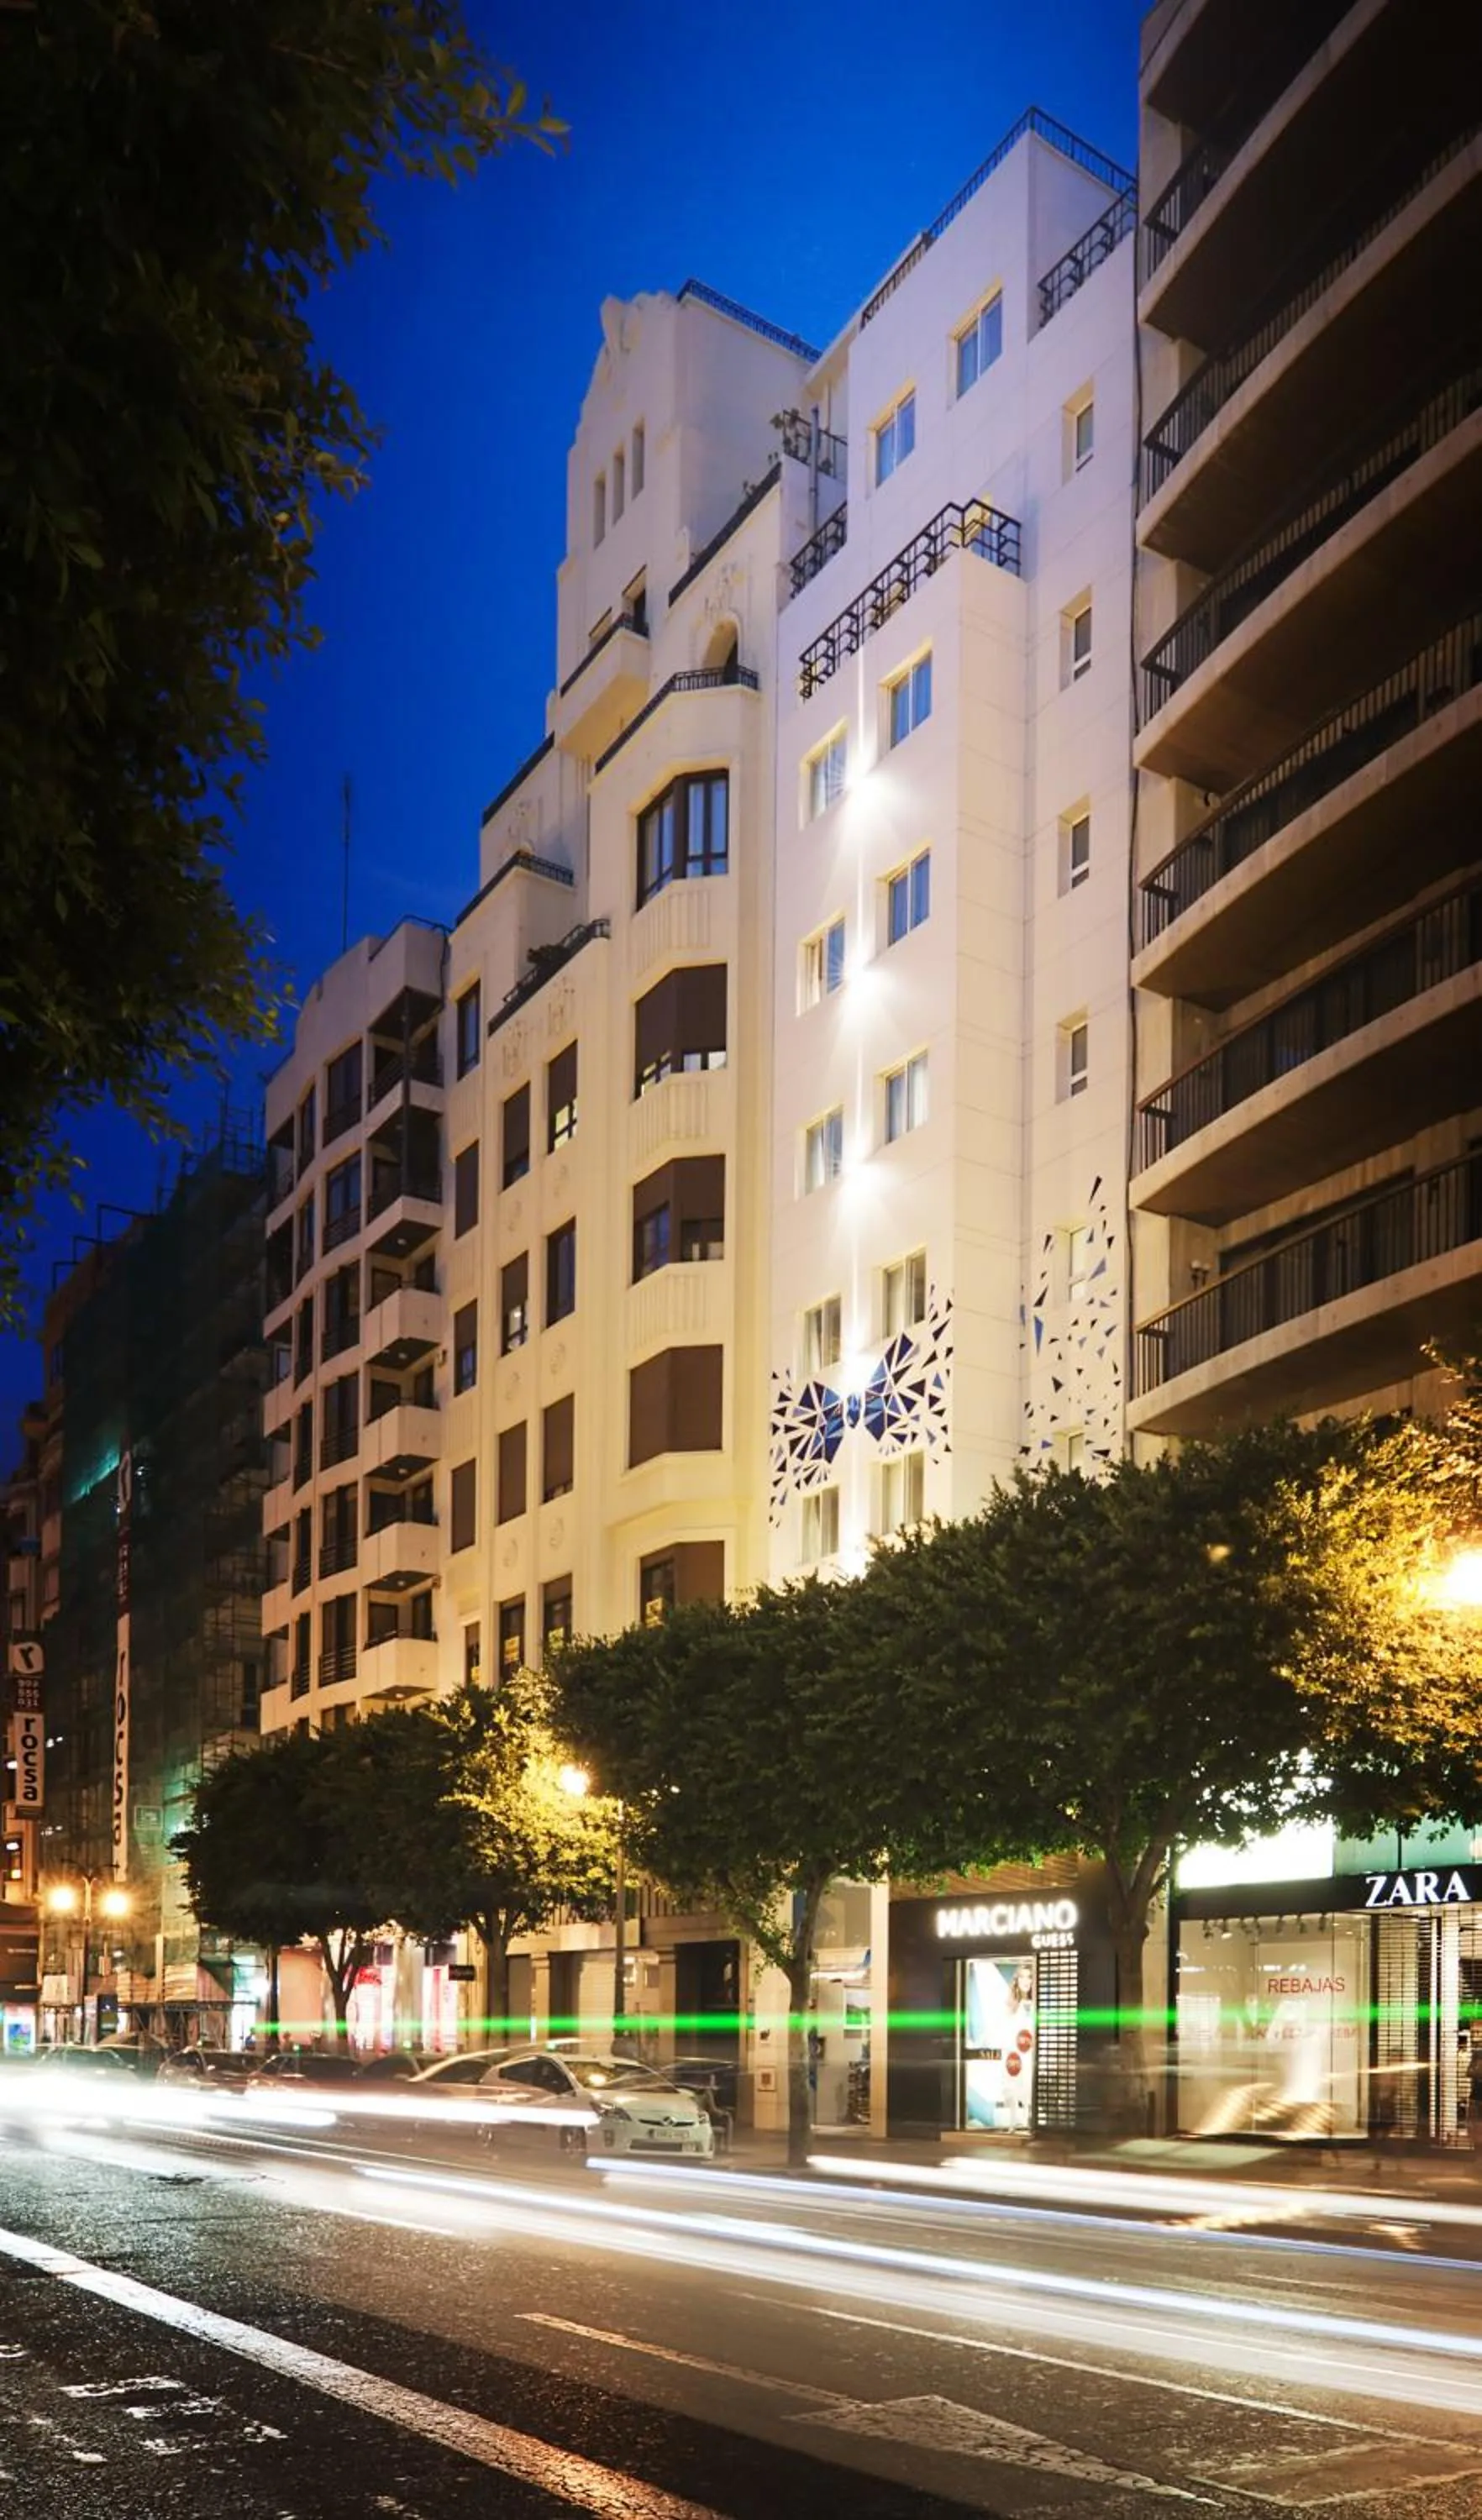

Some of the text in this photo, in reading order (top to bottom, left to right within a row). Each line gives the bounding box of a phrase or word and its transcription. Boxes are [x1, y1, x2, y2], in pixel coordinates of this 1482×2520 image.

[21, 1718, 38, 1801] rocsa
[1365, 1870, 1471, 1908] ZARA
[937, 1899, 1078, 1938] MARCIANO
[1031, 1933, 1075, 1949] GUESS
[1268, 1977, 1346, 1994] REBAJAS
